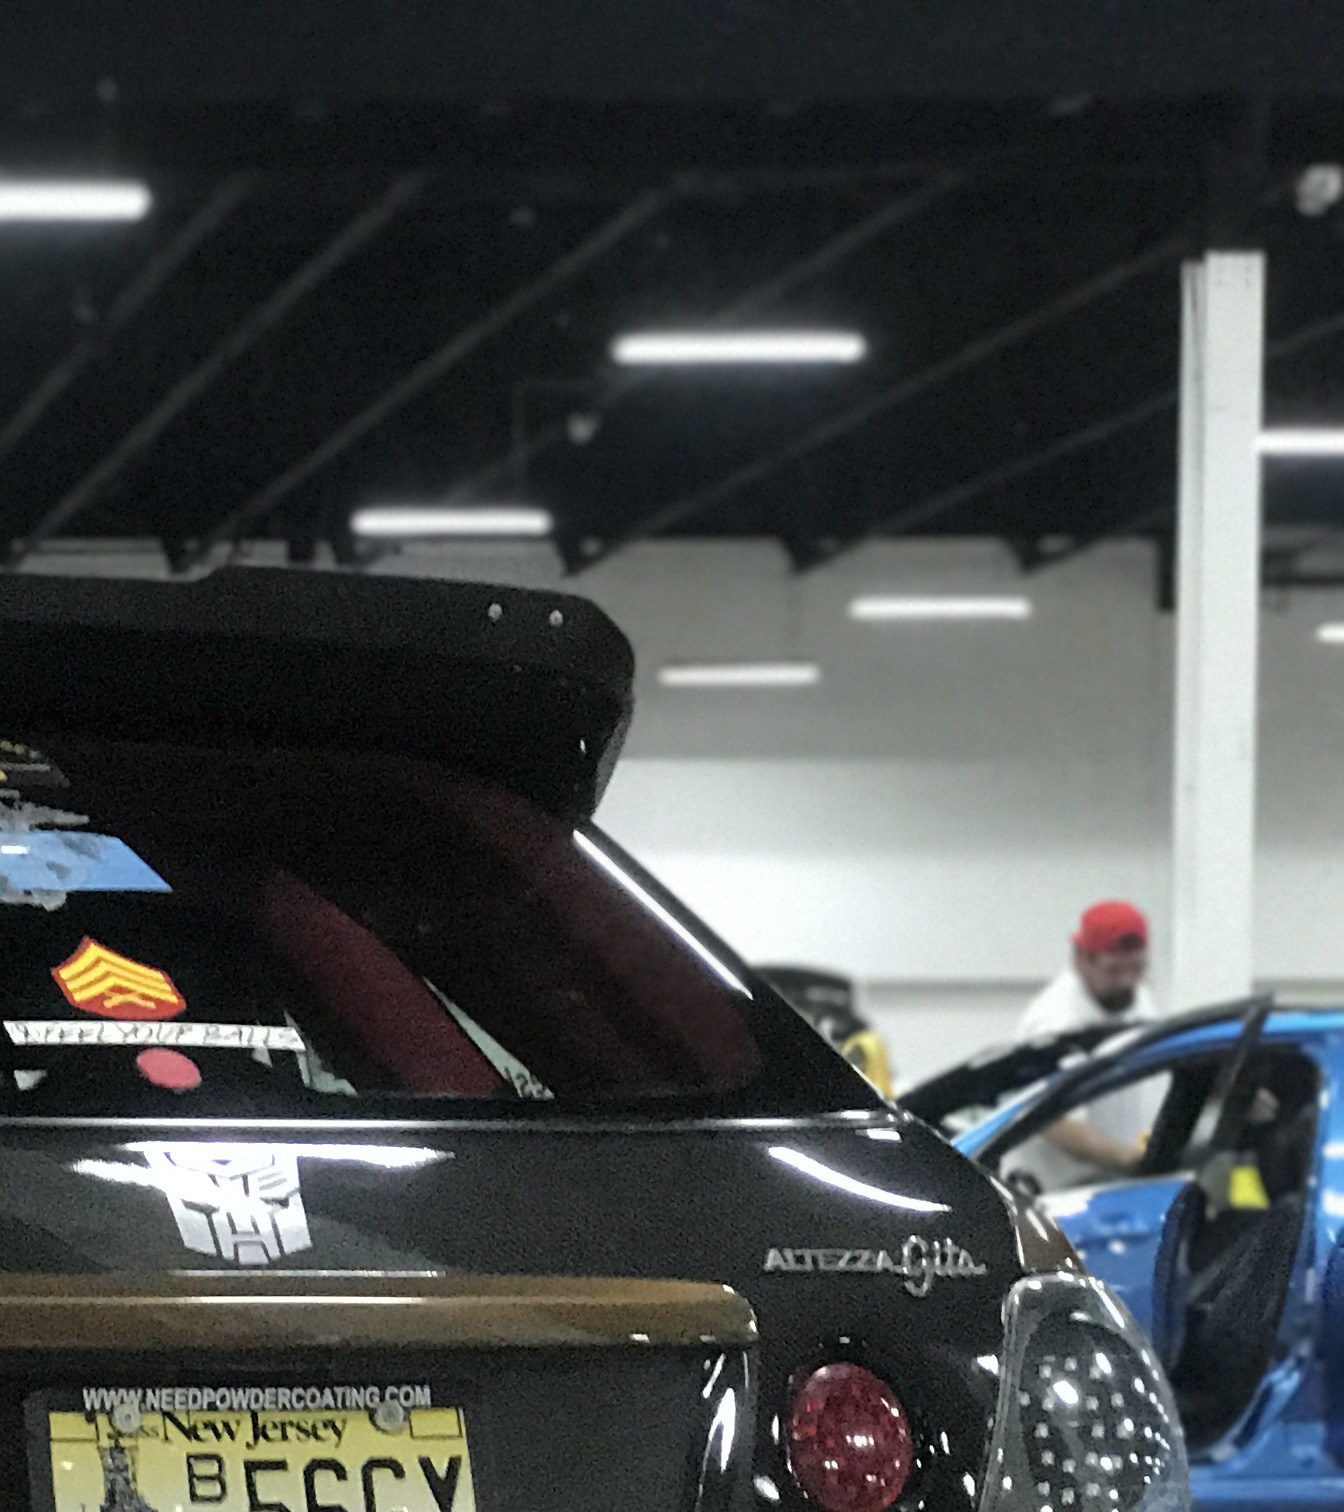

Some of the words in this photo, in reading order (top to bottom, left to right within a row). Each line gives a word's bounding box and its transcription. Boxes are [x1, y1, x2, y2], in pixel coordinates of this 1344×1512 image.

[82, 1385, 431, 1413] WWW.NEEDPOWDERCOATINGCOM
[162, 1409, 242, 1443] New
[245, 1408, 349, 1449] Jersey
[186, 1453, 228, 1503] B
